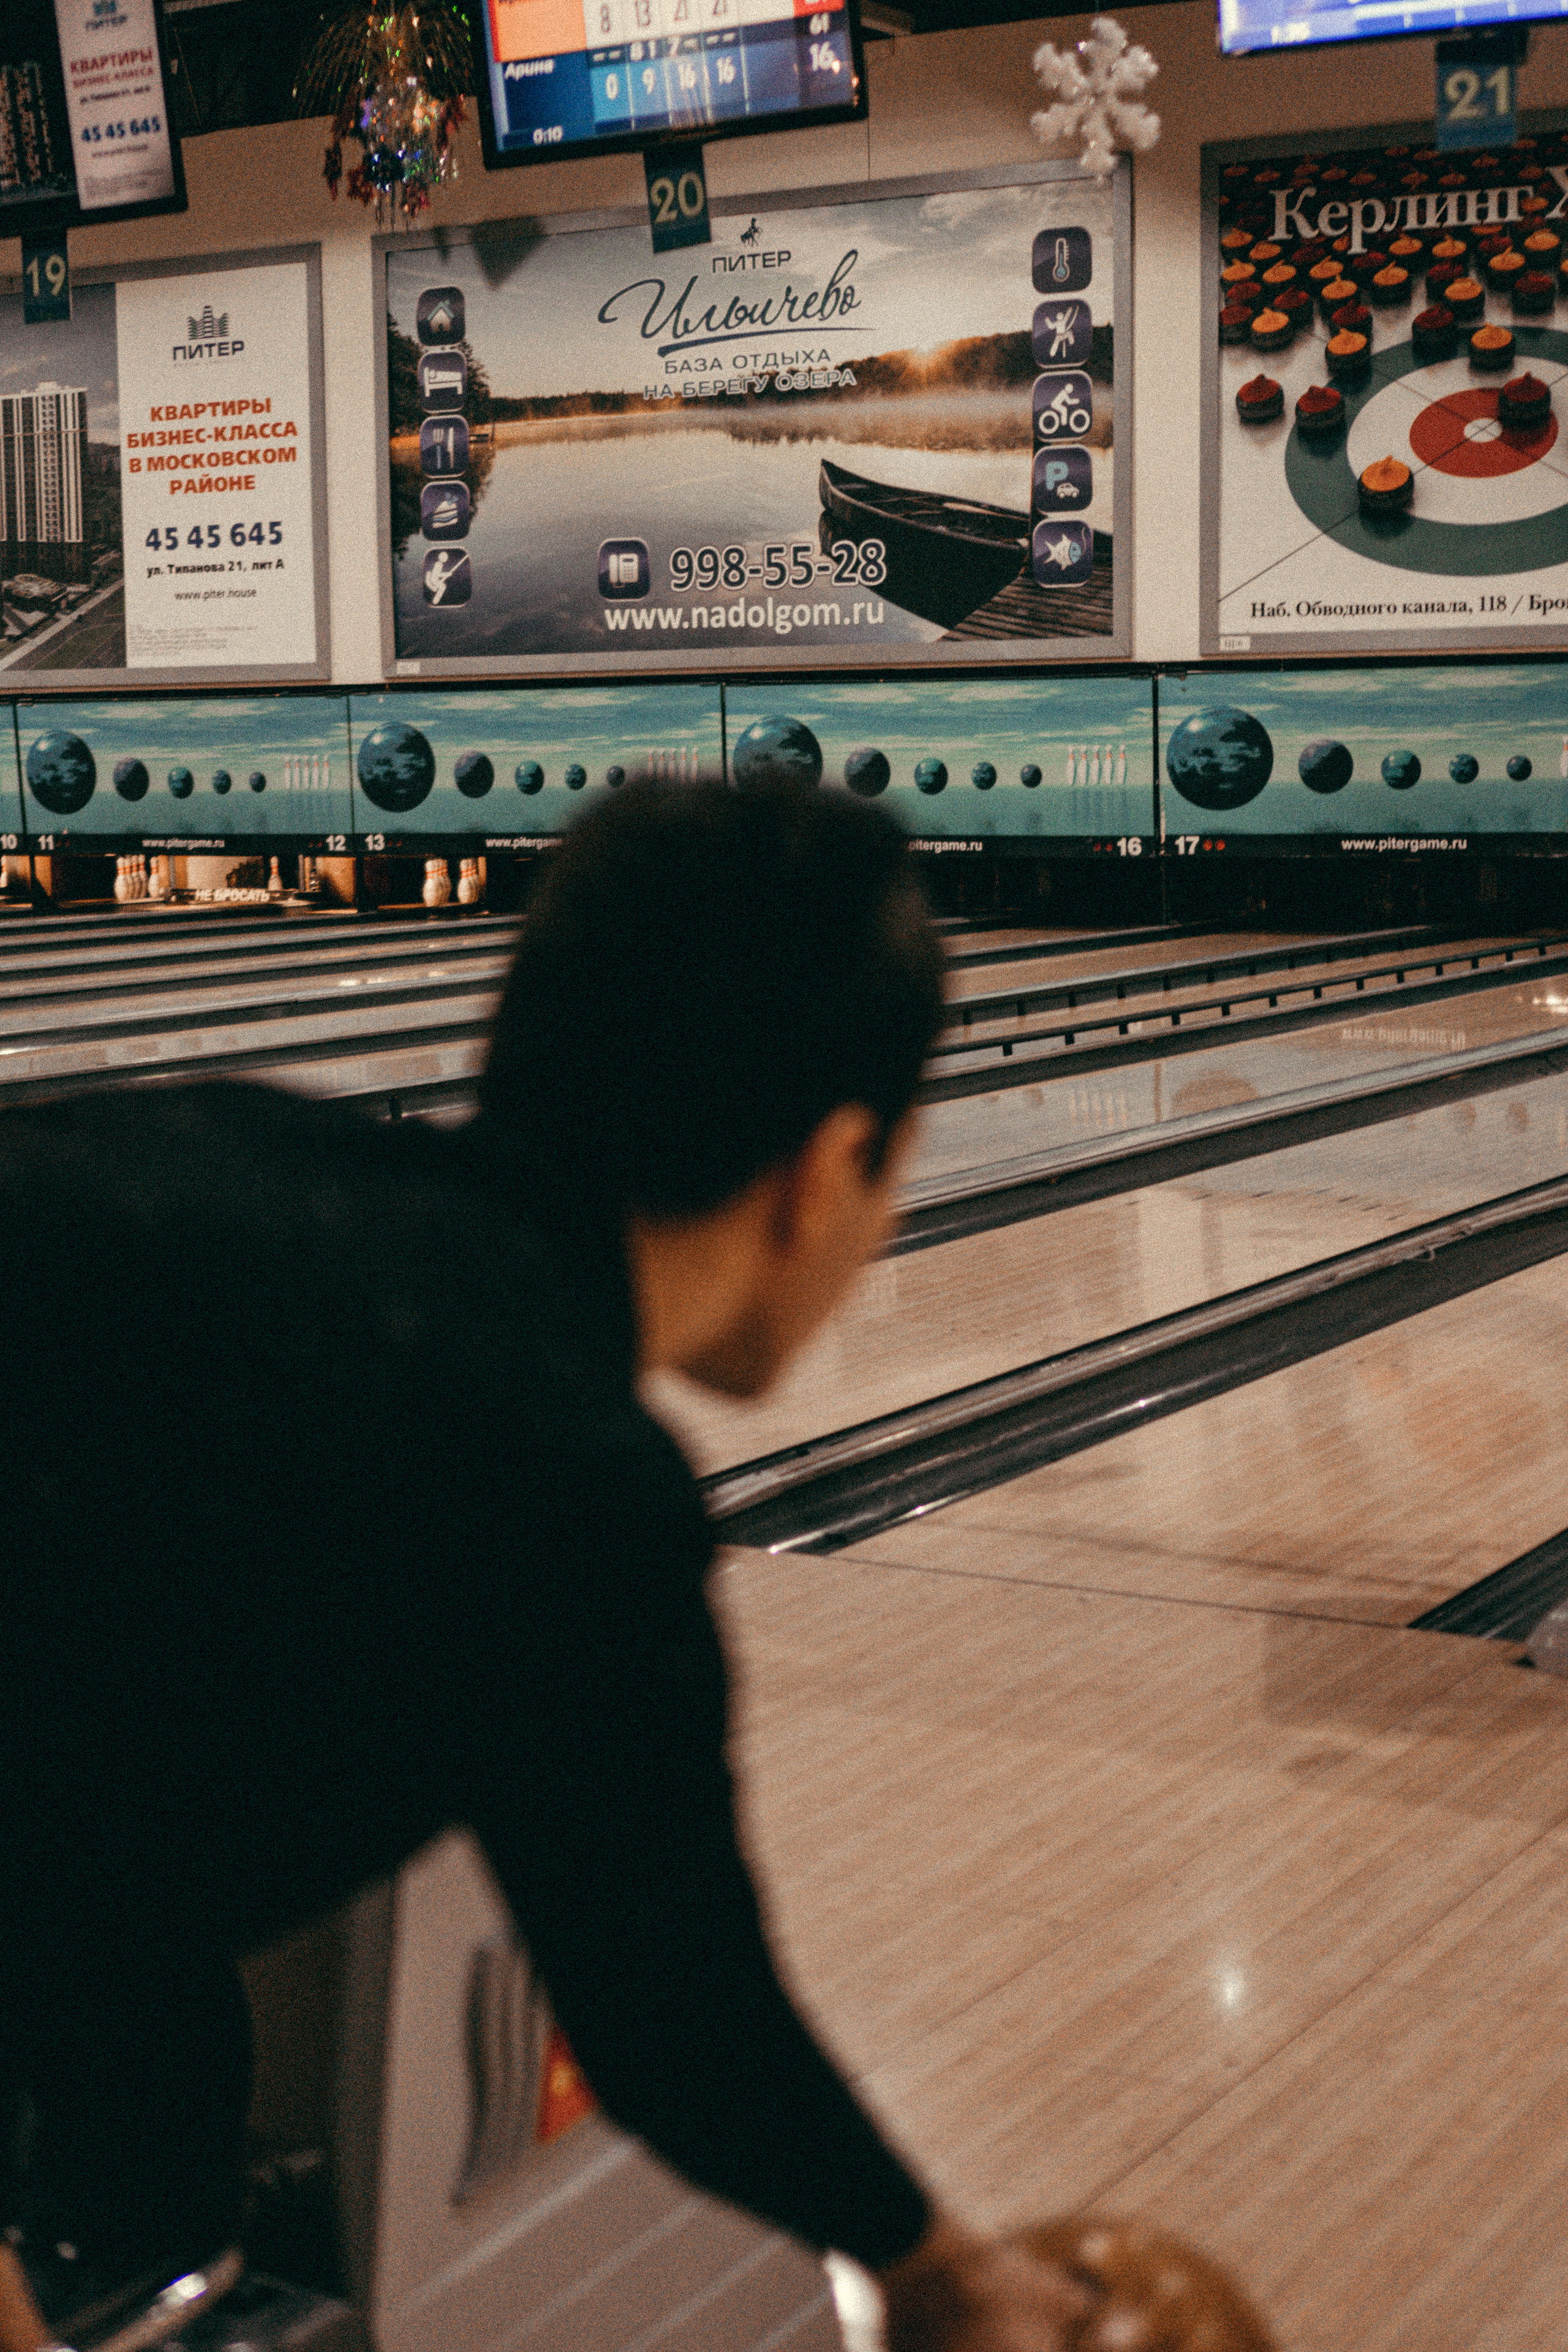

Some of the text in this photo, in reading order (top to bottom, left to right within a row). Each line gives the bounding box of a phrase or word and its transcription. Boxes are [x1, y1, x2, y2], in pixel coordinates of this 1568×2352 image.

[600, 4, 611, 33] 8
[70, 46, 153, 74] КВАРТИРЫ
[809, 41, 834, 71] 16
[505, 59, 555, 81] Арина
[606, 73, 618, 100] 0
[643, 67, 655, 95] 9
[717, 56, 735, 85] 16
[1445, 66, 1510, 121] 21
[81, 115, 161, 142] 45 45 645
[650, 172, 704, 224] 20
[1268, 186, 1535, 255] Керлинг
[712, 250, 791, 273] ПИТЕР
[25, 255, 66, 297] 19
[597, 249, 861, 339] Ильичево
[173, 340, 244, 361] ПИТЕР
[665, 348, 831, 374] БАЗА ОТДЫХА
[643, 368, 856, 401] НА БЕРЕГУ ОЗЕРА
[150, 398, 272, 423] КВАРТИРЫ
[127, 421, 298, 448] БИЗНЕС-КЛАССА
[129, 447, 297, 473] В МОСКОВСКОМ
[169, 473, 255, 495] РАЙОНЕ
[145, 521, 283, 551] 45 45 645
[147, 559, 284, 578] ул. Типанова 21, лит А
[669, 538, 887, 592] 998-55-28
[604, 597, 884, 635] www.nadolgom.ru
[1251, 601, 1291, 618] Наб.
[1296, 600, 1397, 618] Обводного
[1403, 599, 1472, 614] канала,
[1480, 595, 1507, 611] 118
[1529, 594, 1568, 616] Бро
[0, 834, 17, 850] 10
[38, 834, 55, 850] 11
[142, 837, 225, 850] www.pitergame.ru
[326, 834, 346, 852] 12
[366, 833, 385, 851] 13
[1117, 837, 1142, 856] 16
[1175, 835, 1200, 855] 17
[1341, 836, 1467, 853] www.pitergame.ru
